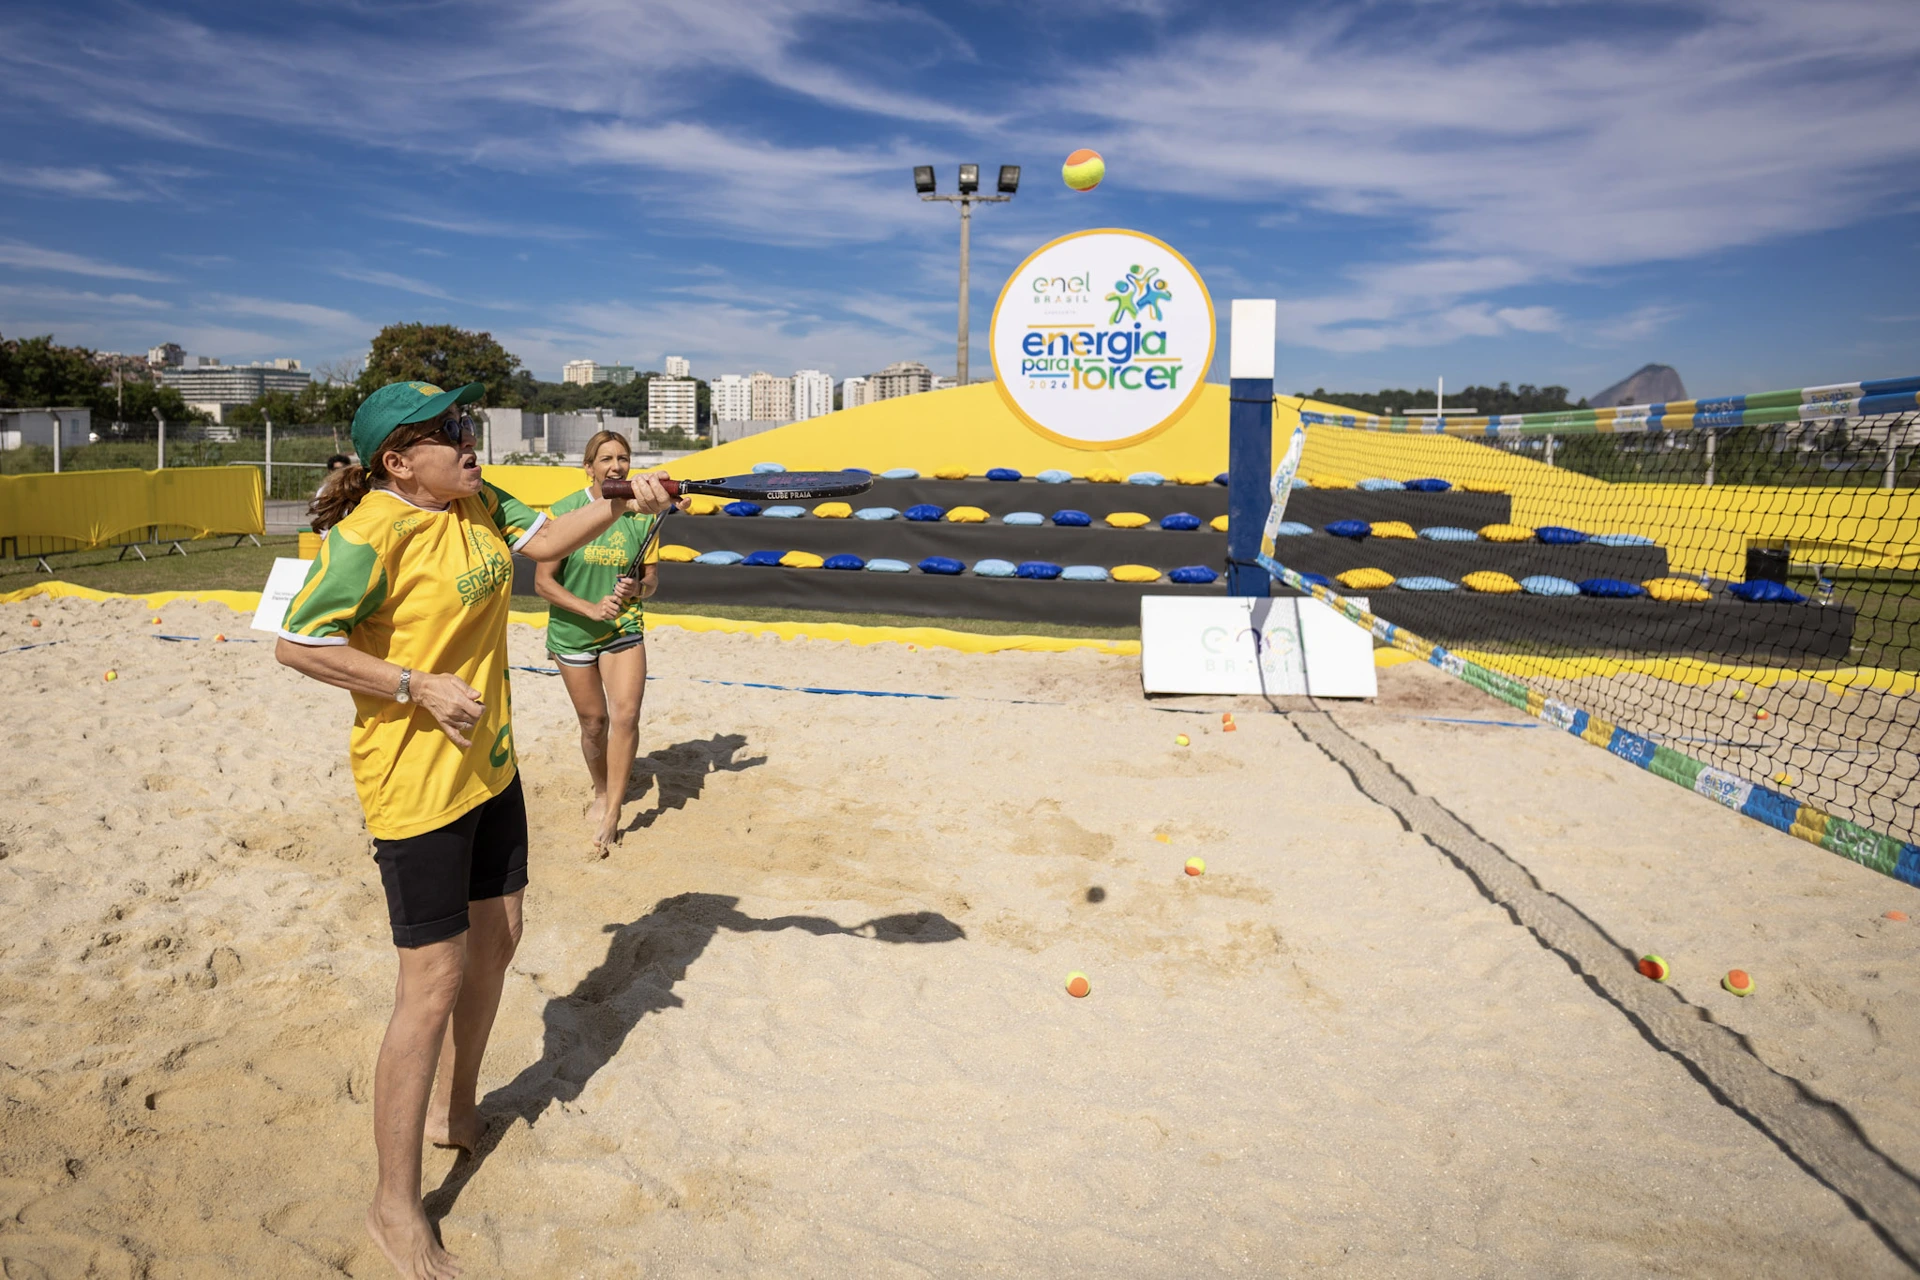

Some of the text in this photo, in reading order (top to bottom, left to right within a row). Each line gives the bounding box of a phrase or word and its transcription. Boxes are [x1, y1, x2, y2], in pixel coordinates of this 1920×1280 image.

[1033, 271, 1090, 293] enel
[1034, 295, 1089, 303] BRASIL
[1022, 322, 1166, 364] energia
[1022, 358, 1183, 390] para torcer
[1029, 380, 1067, 389] 2026
[767, 491, 811, 500] CLUBE PRAIA
[584, 546, 625, 558] energia
